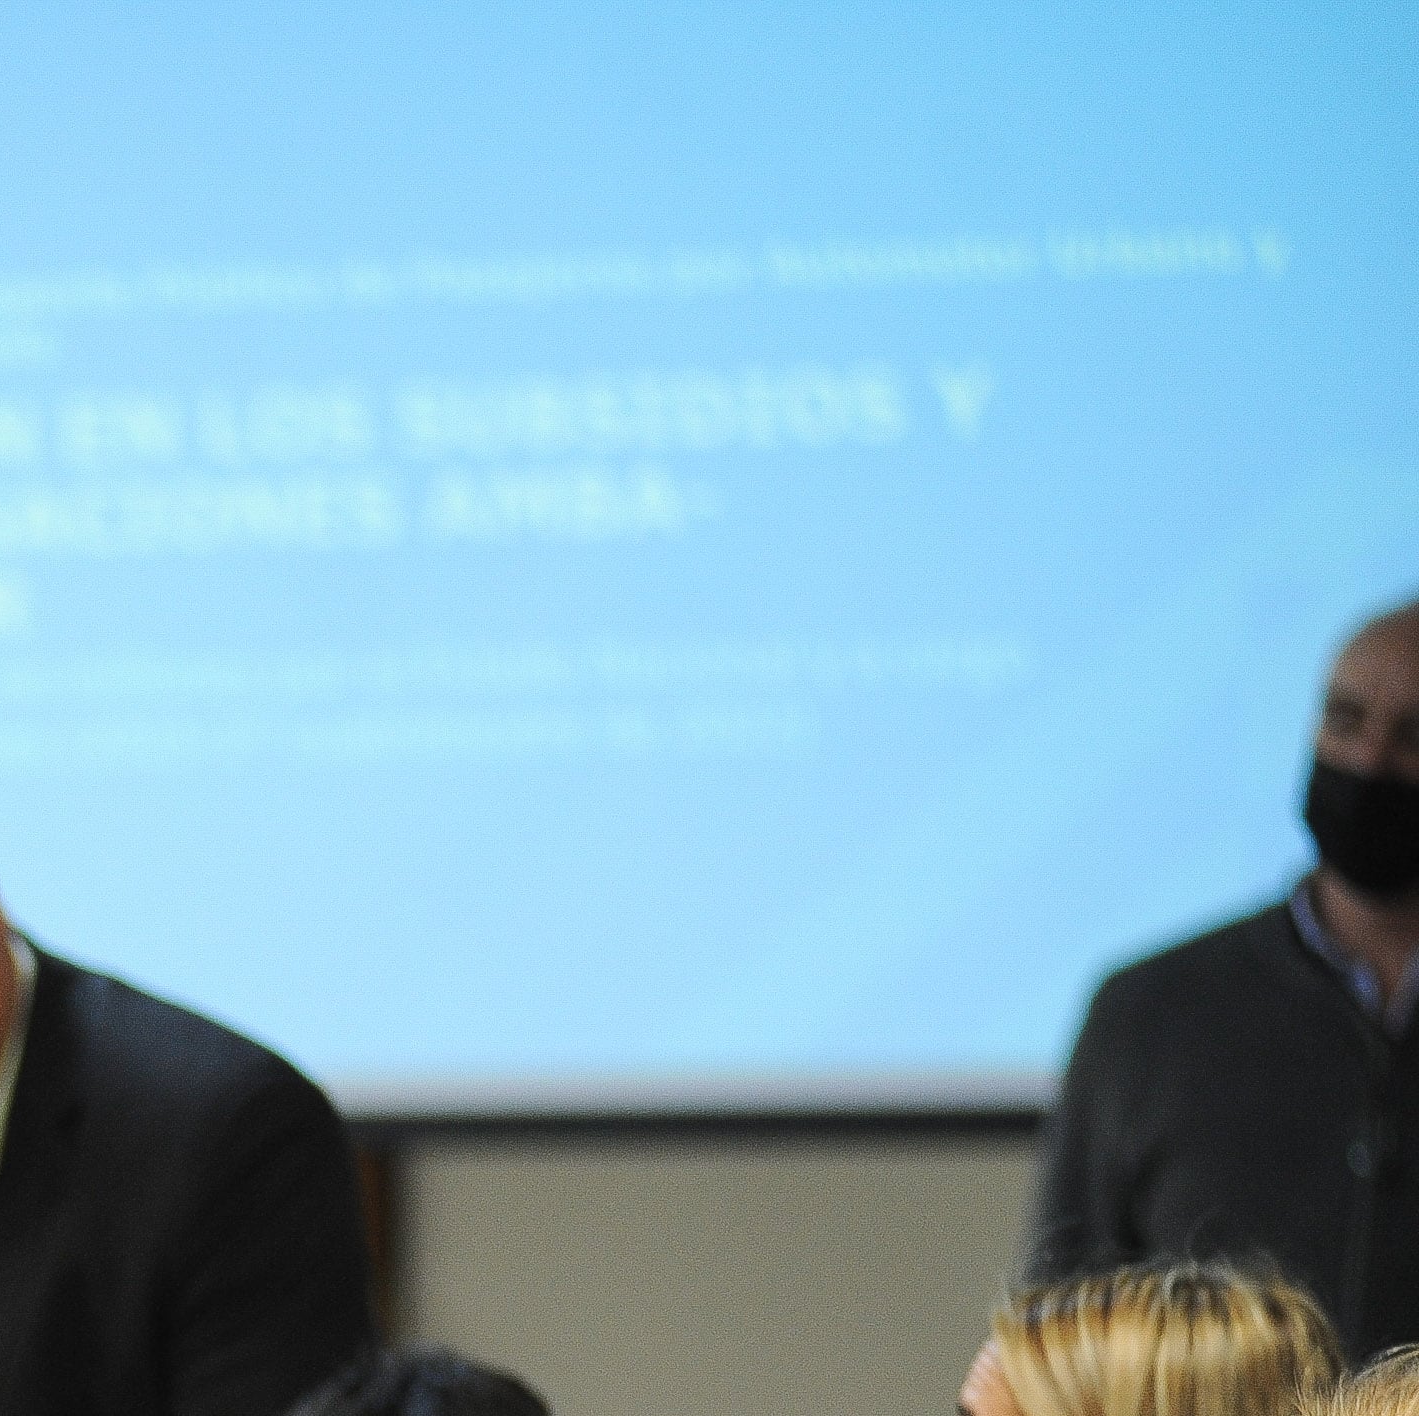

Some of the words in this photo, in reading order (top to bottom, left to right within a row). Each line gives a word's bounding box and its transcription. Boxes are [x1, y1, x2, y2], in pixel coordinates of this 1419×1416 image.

[57, 388, 184, 466] EN
[197, 382, 377, 464] LOS
[391, 362, 911, 458] SUBSIDIOS
[929, 360, 997, 443] Y
